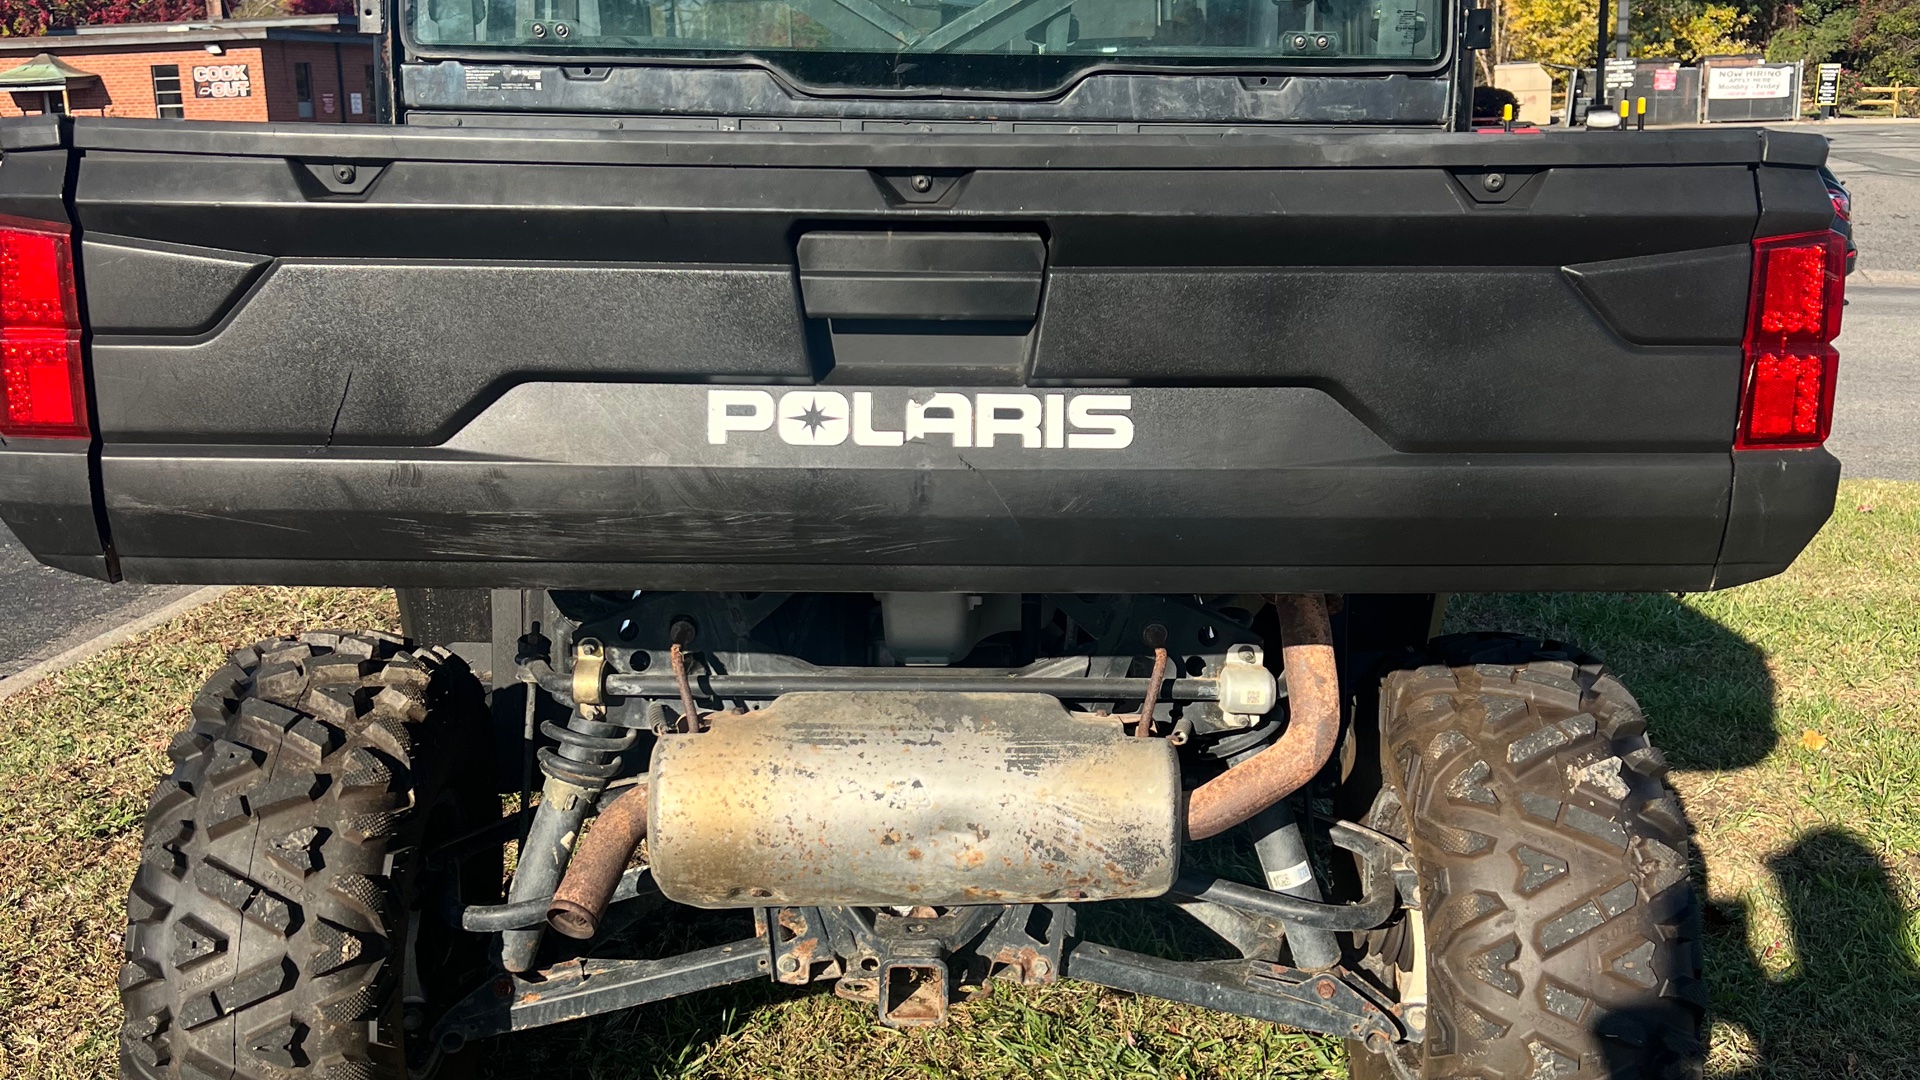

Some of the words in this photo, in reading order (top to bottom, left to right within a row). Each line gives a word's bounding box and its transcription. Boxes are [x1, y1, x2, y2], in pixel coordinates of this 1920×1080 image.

[193, 64, 249, 82] COOK
[1719, 70, 1742, 78] NOW
[1746, 70, 1782, 78] HIRING
[707, 389, 1135, 450] POLARIS
